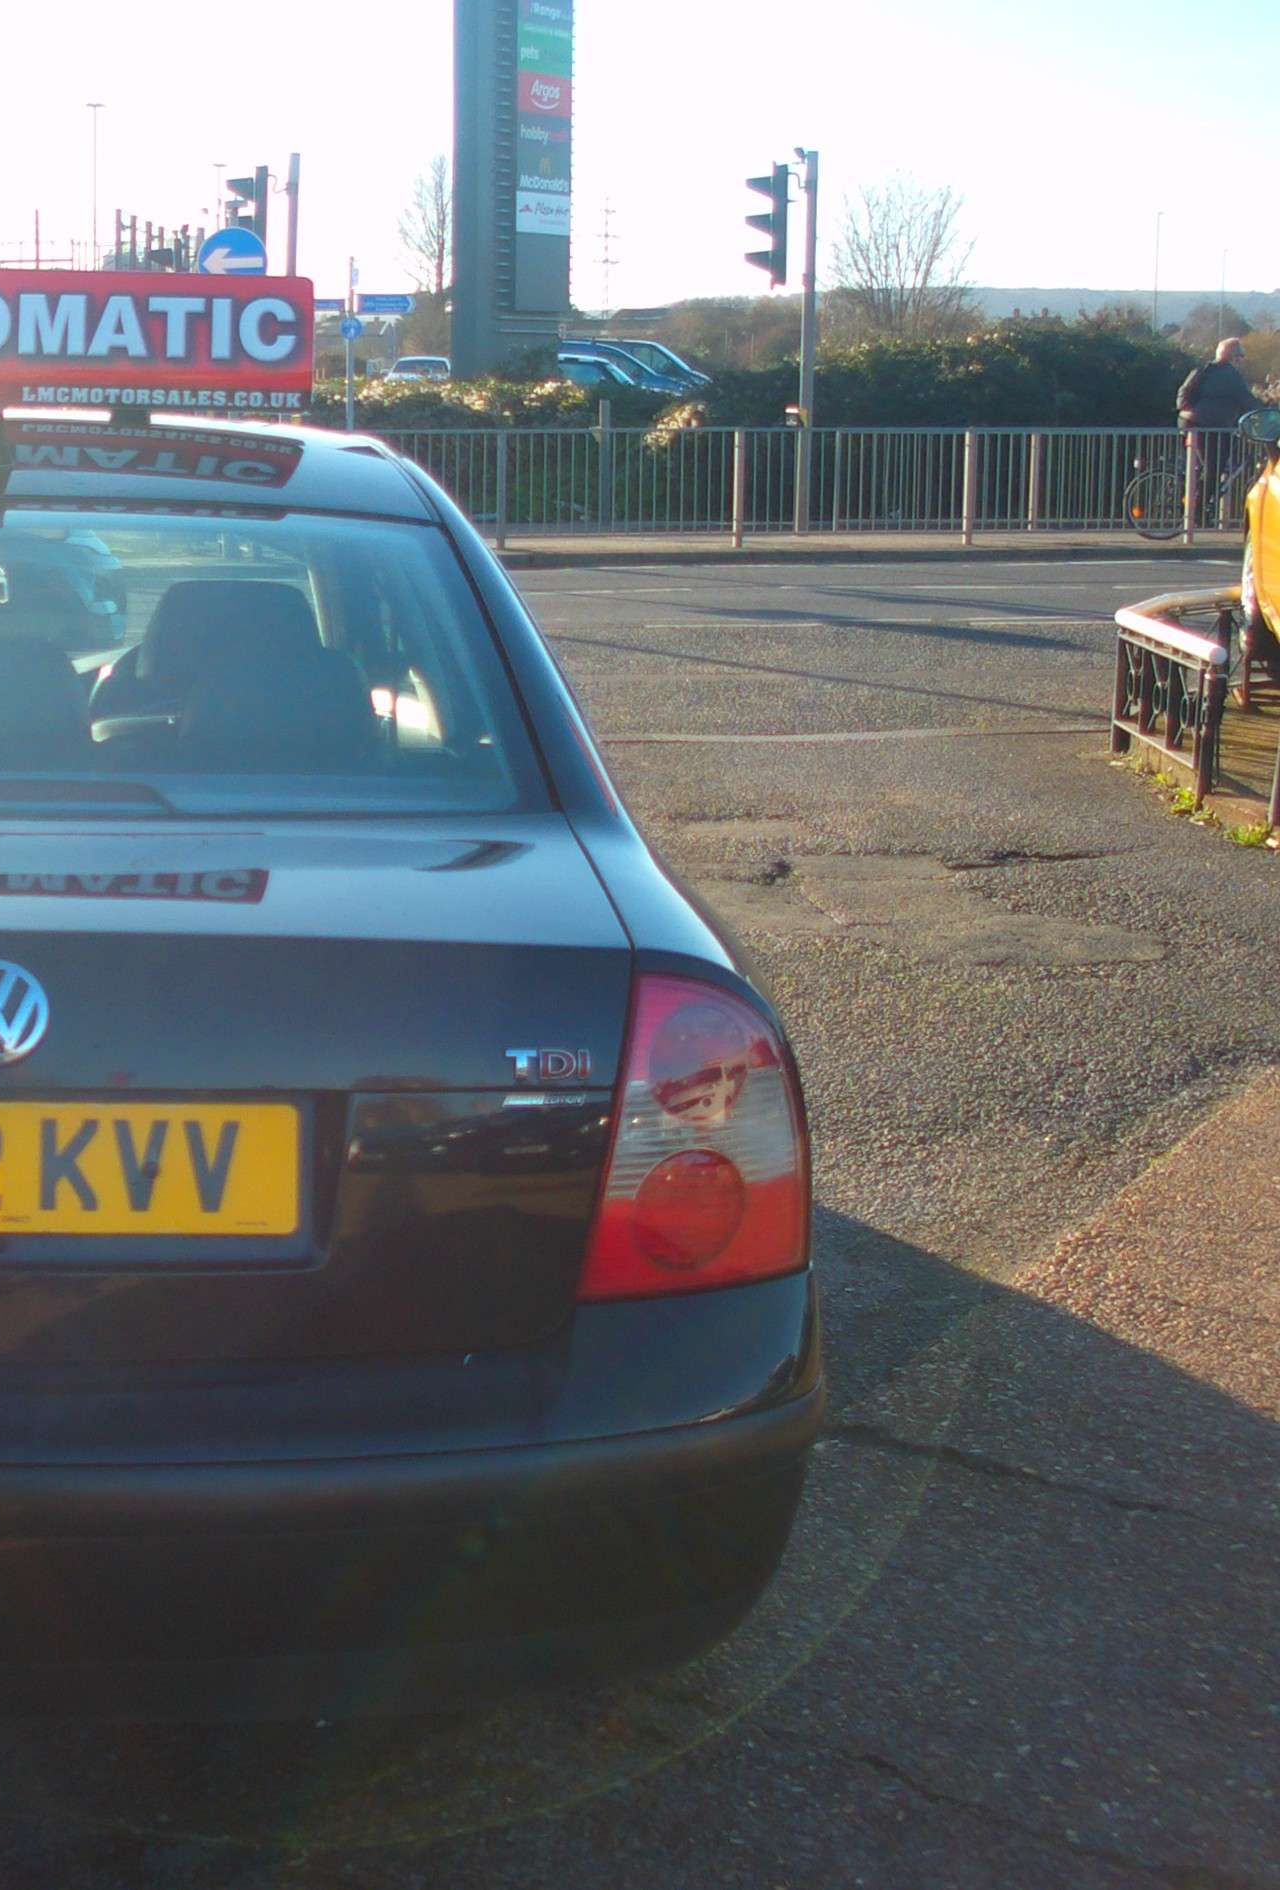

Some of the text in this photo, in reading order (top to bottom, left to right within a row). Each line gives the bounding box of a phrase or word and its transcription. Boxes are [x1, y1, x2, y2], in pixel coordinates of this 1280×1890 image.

[530, 79, 561, 102] Argos
[520, 174, 570, 193] McDonald's
[21, 386, 302, 408] LMCMOTORSALES.CO.UK
[504, 1048, 592, 1080] TDI
[39, 1118, 241, 1213] KVV
